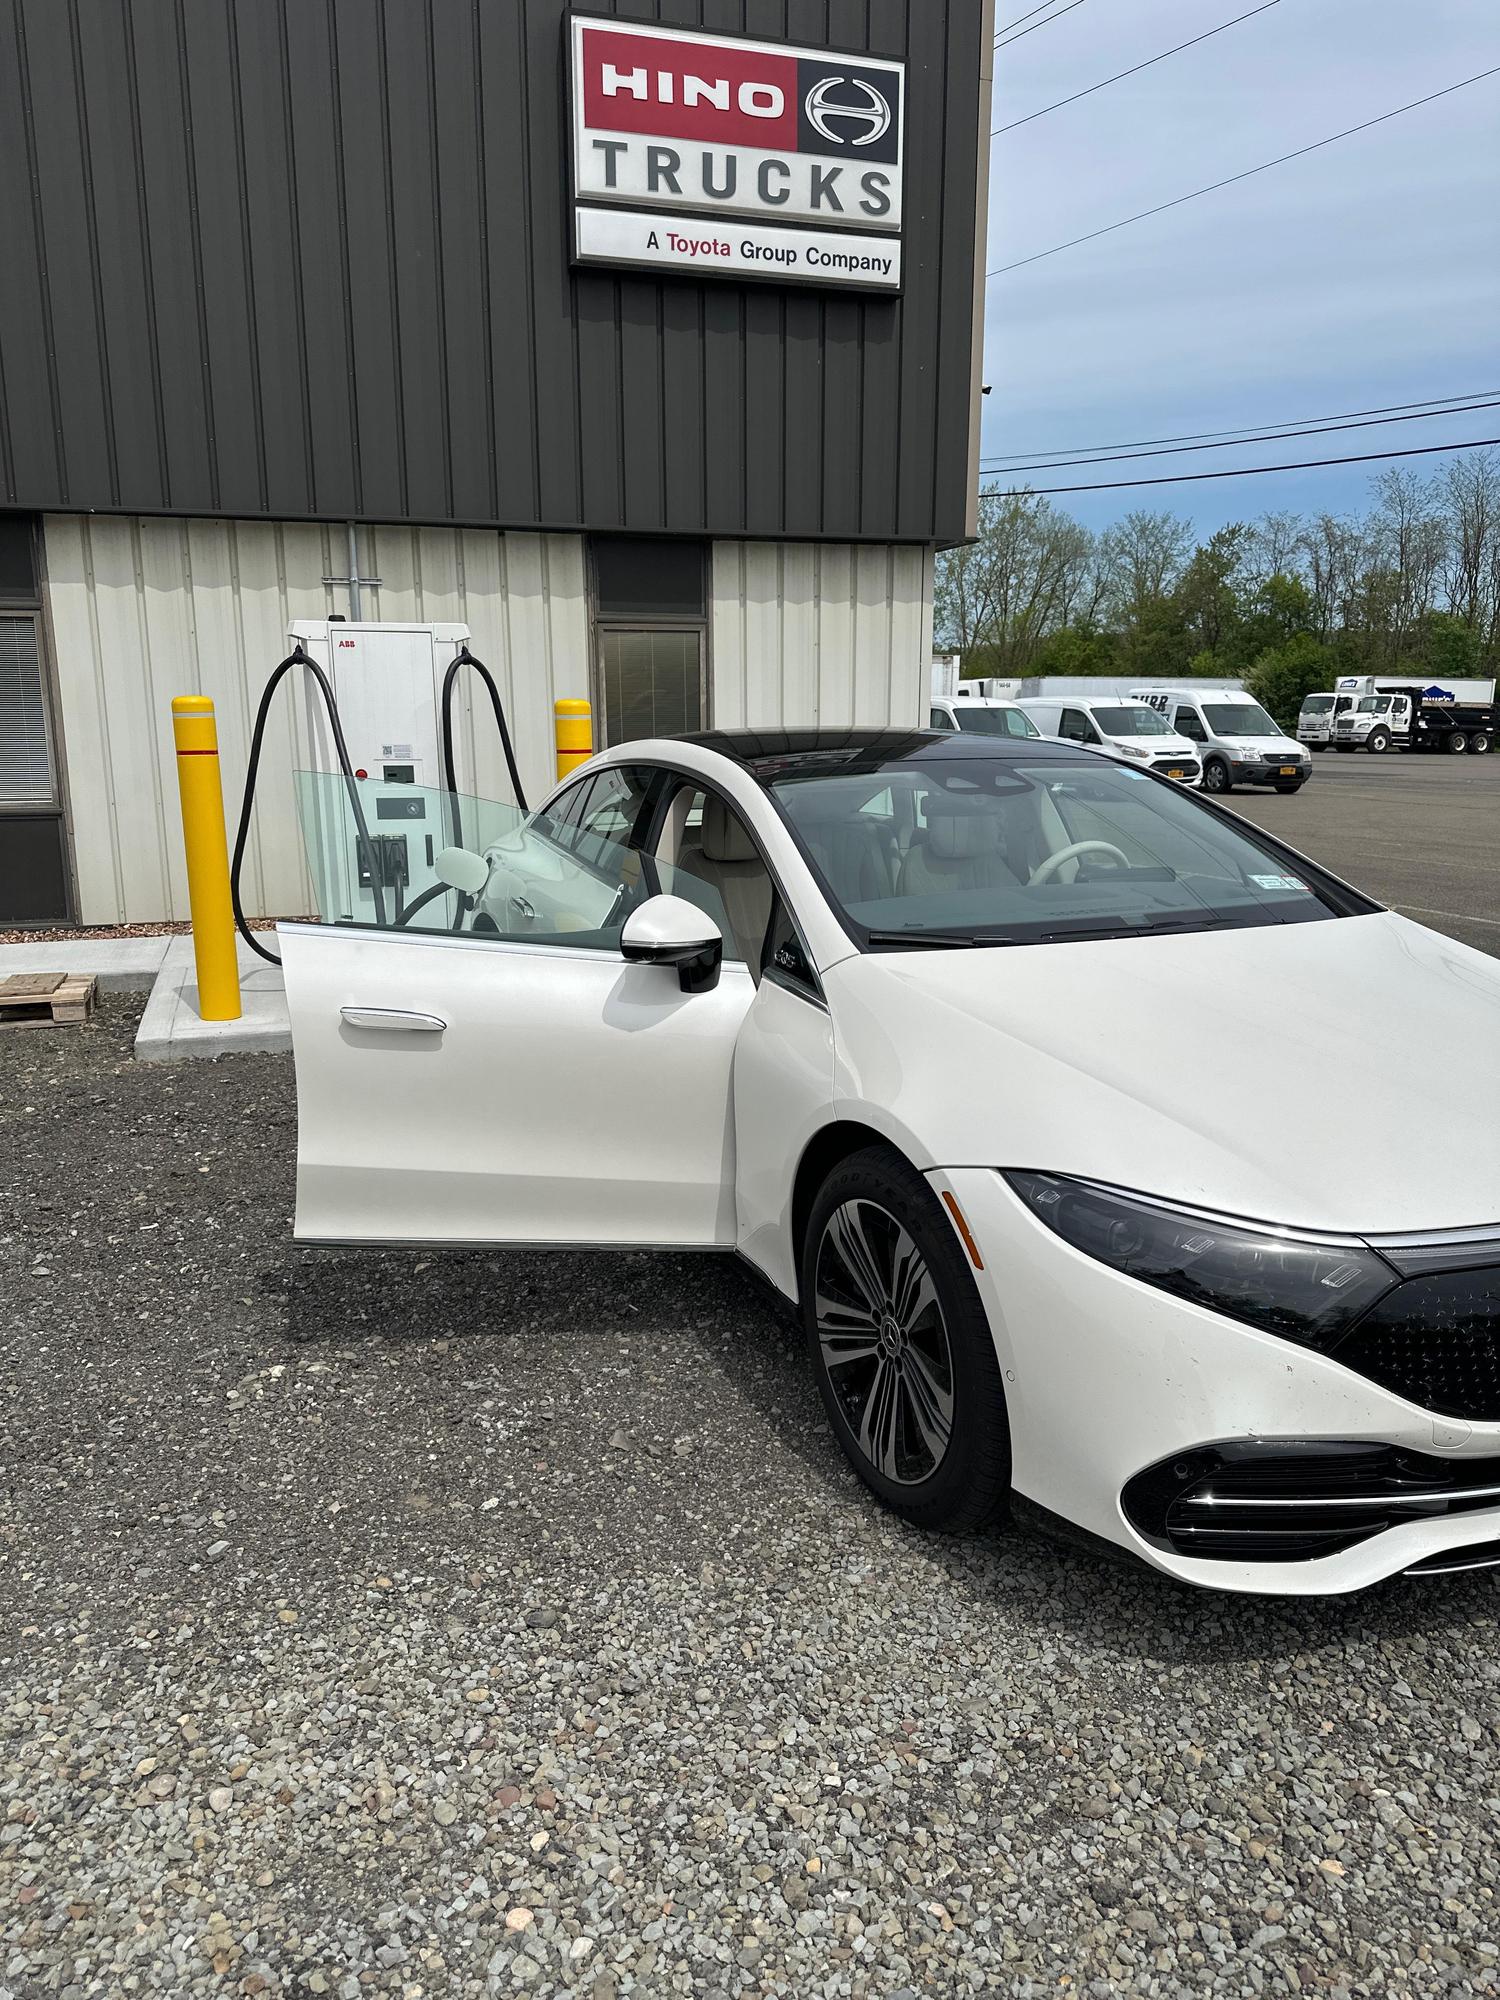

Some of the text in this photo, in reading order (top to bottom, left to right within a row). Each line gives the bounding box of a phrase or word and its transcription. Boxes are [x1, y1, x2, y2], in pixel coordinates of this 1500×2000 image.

[601, 62, 785, 119] HINO
[592, 139, 891, 216] TRUCKS
[646, 231, 892, 275] A Toyota Group Company
[338, 640, 356, 648] ABB
[1130, 695, 1169, 712] RR
